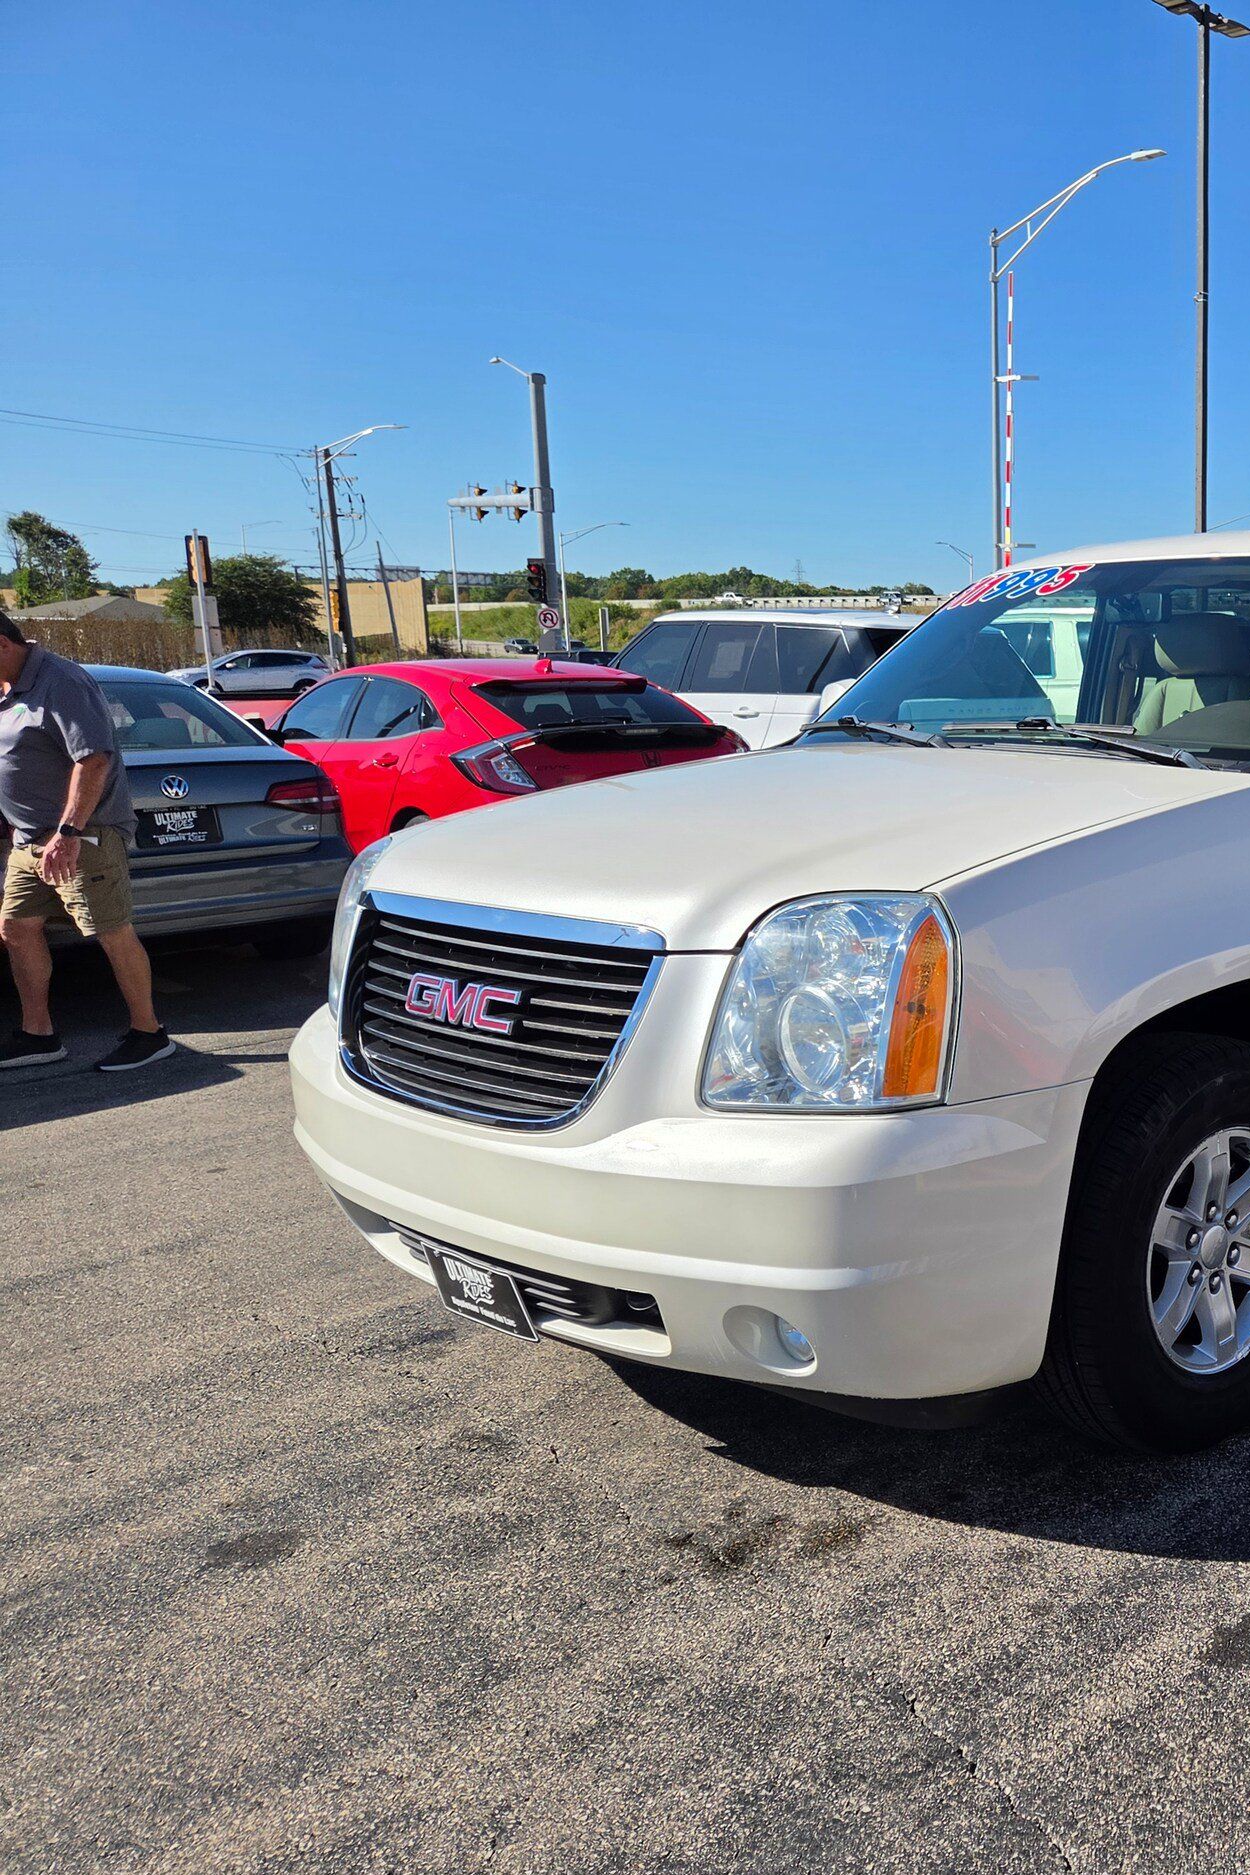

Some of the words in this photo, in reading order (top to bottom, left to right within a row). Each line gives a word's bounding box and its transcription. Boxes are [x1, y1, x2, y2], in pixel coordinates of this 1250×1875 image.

[153, 810, 198, 827] ULTIMATE
[405, 973, 521, 1035] GMC
[442, 1256, 494, 1288] ULTIMATE
